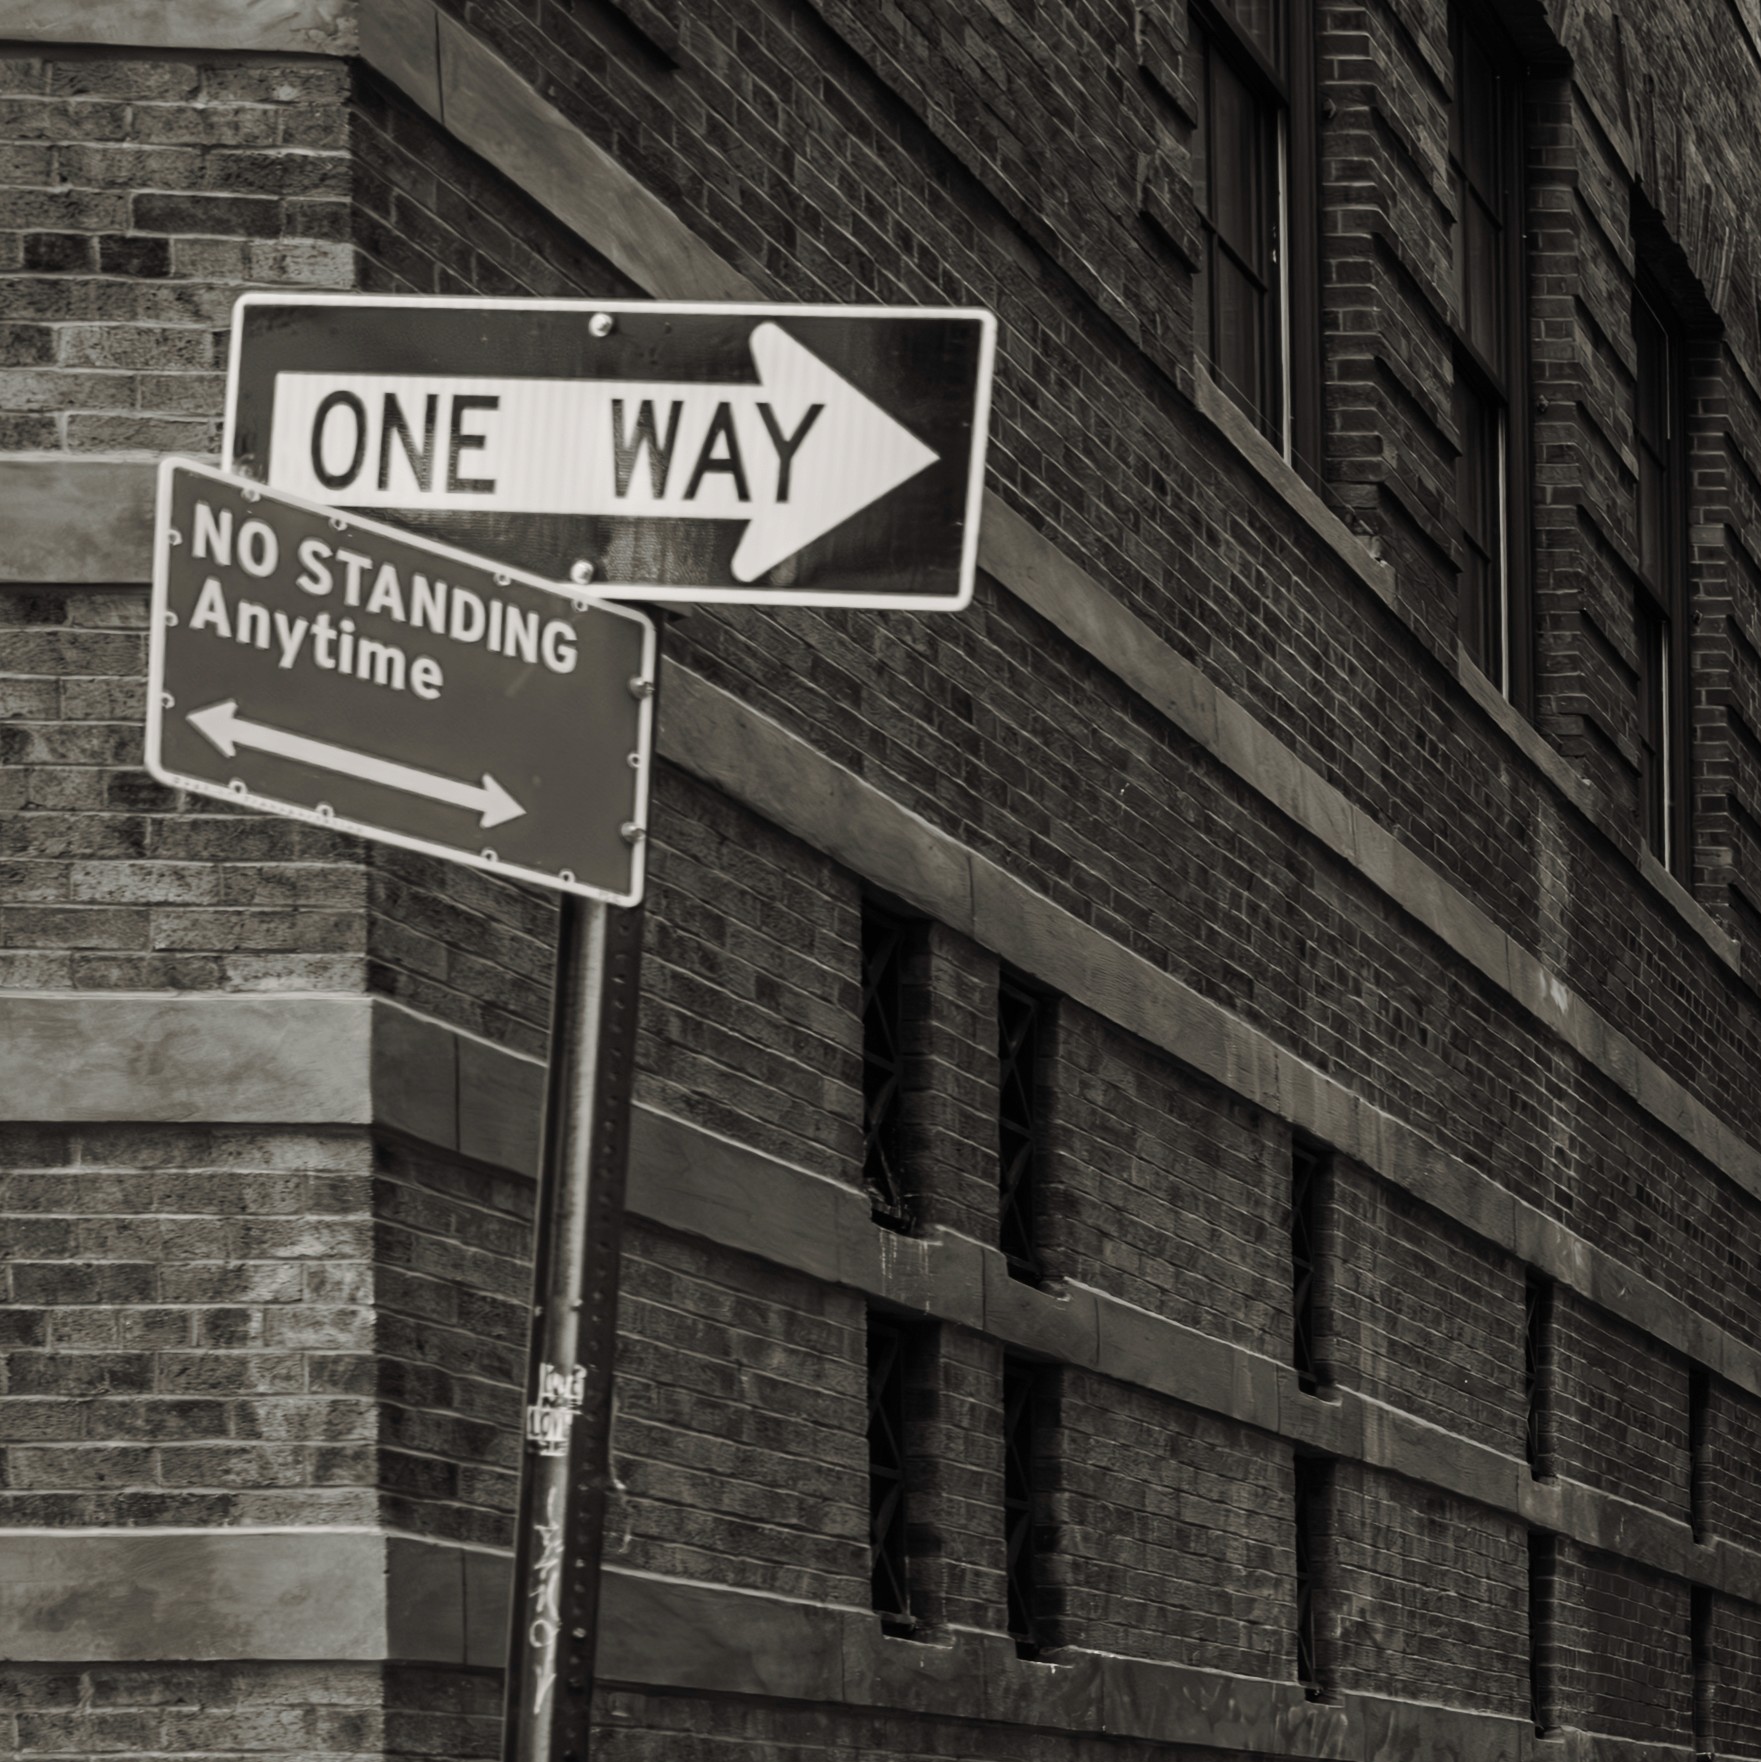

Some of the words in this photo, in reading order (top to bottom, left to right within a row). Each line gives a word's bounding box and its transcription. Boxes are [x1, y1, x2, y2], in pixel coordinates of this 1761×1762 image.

[310, 389, 500, 494] ONE
[611, 398, 826, 503] WAY
[188, 576, 444, 700] Anytime
[191, 500, 279, 578] NO
[295, 537, 579, 674] STANDING
